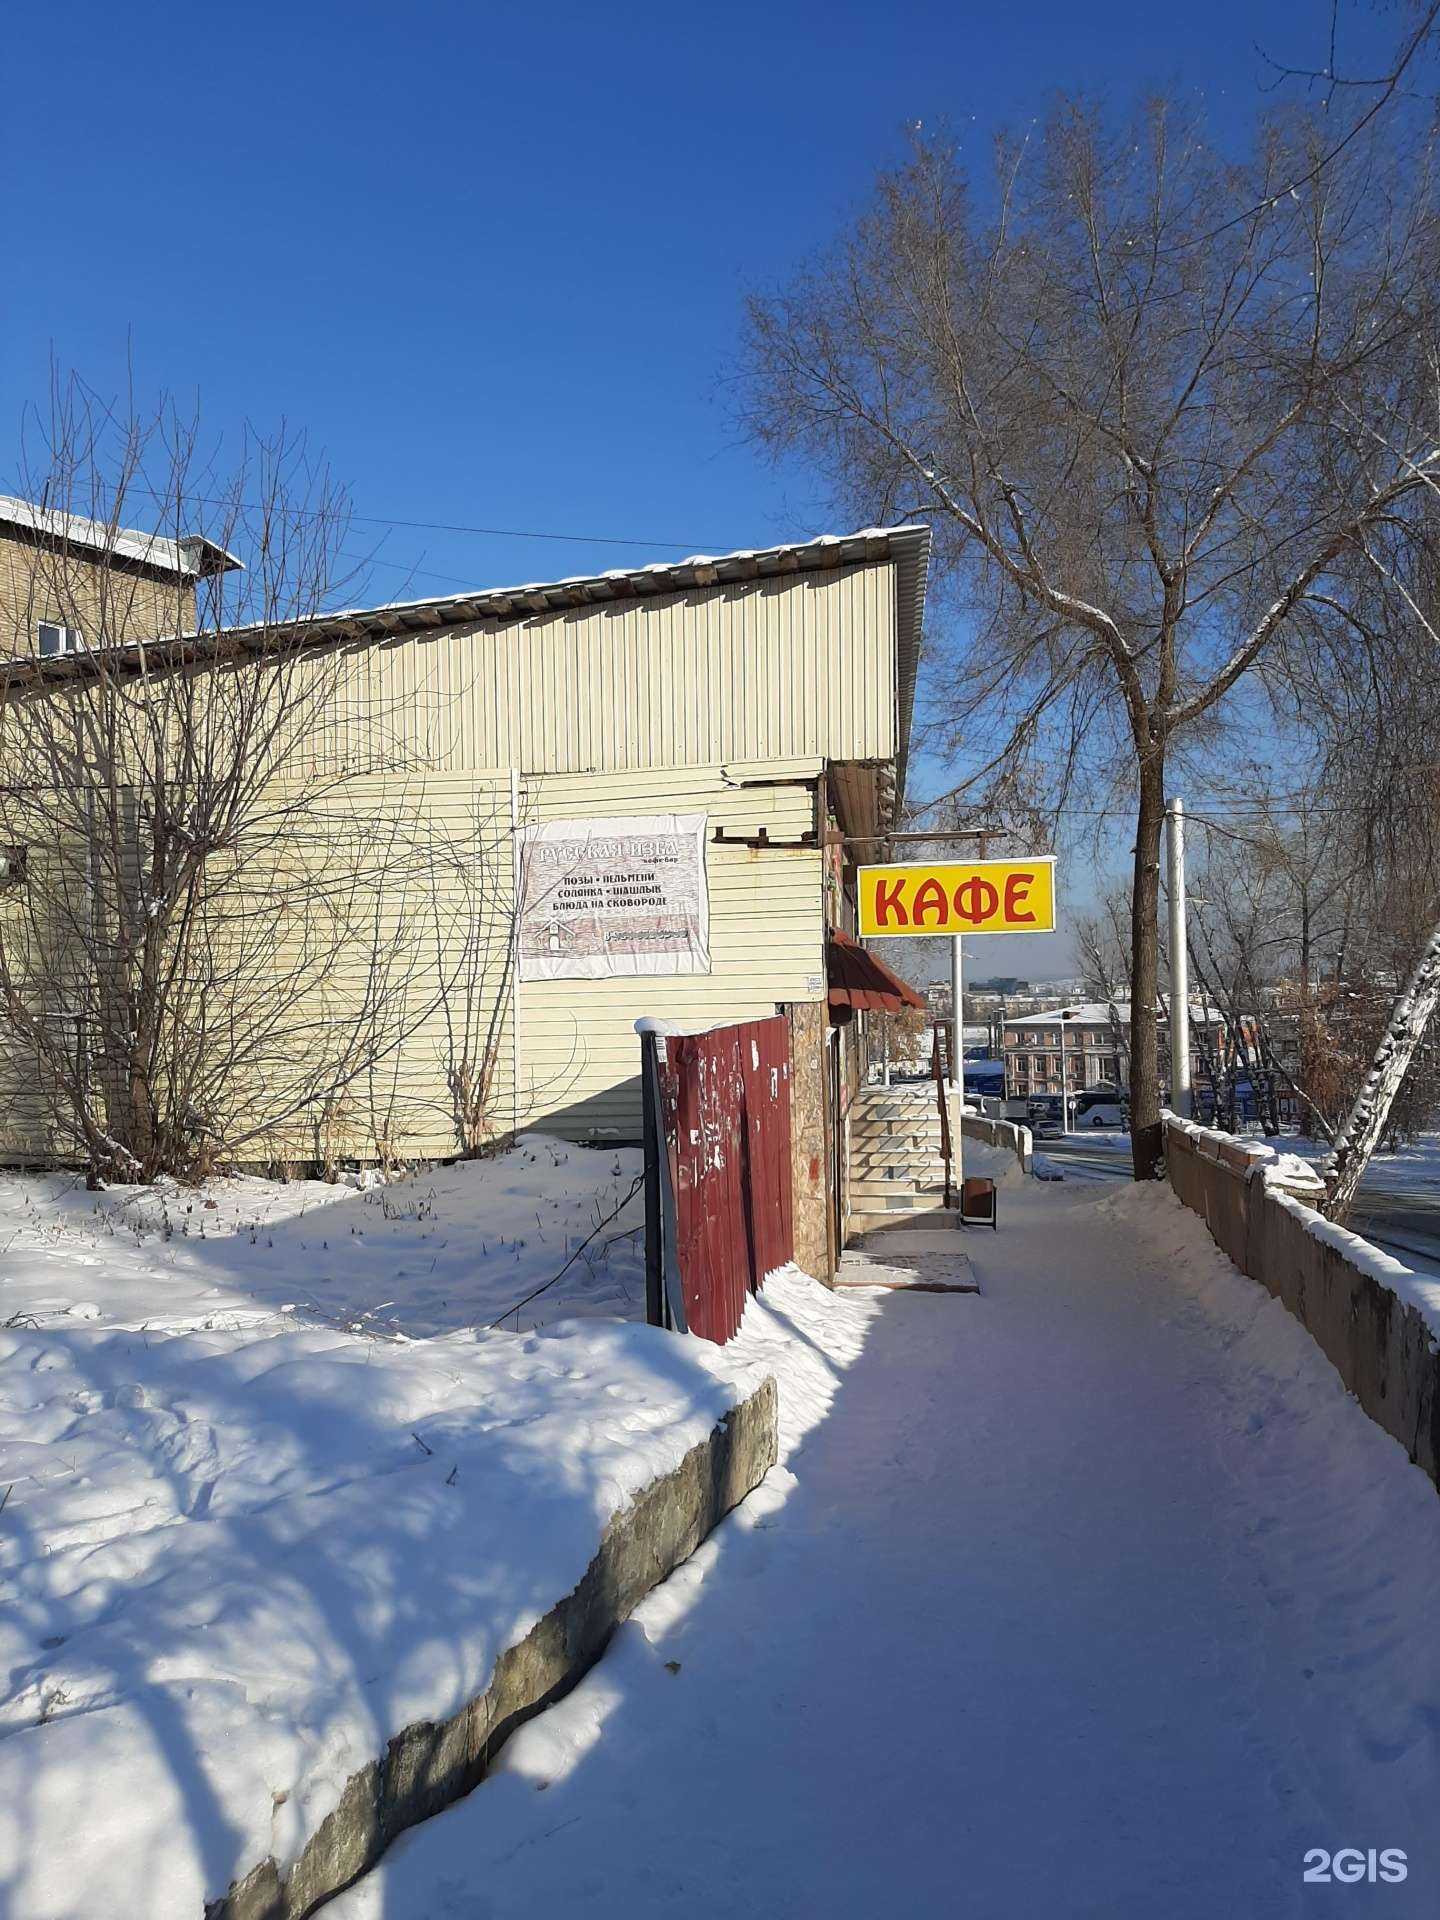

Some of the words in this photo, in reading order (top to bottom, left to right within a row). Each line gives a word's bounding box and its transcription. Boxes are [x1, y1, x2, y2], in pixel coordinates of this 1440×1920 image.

[540, 842, 622, 864] РУССКАЯ
[564, 876, 593, 885] ПОЗЫ
[603, 873, 655, 883] ПЕЛЬМЕНИ
[558, 888, 603, 898] СОЛЯНКА
[613, 885, 661, 895] ШАШЛЫК
[552, 901, 588, 910] БЛЮДА
[591, 900, 604, 908] НА
[607, 898, 667, 907] СКОВОРОДЕ
[875, 874, 1036, 926] КАФЕ
